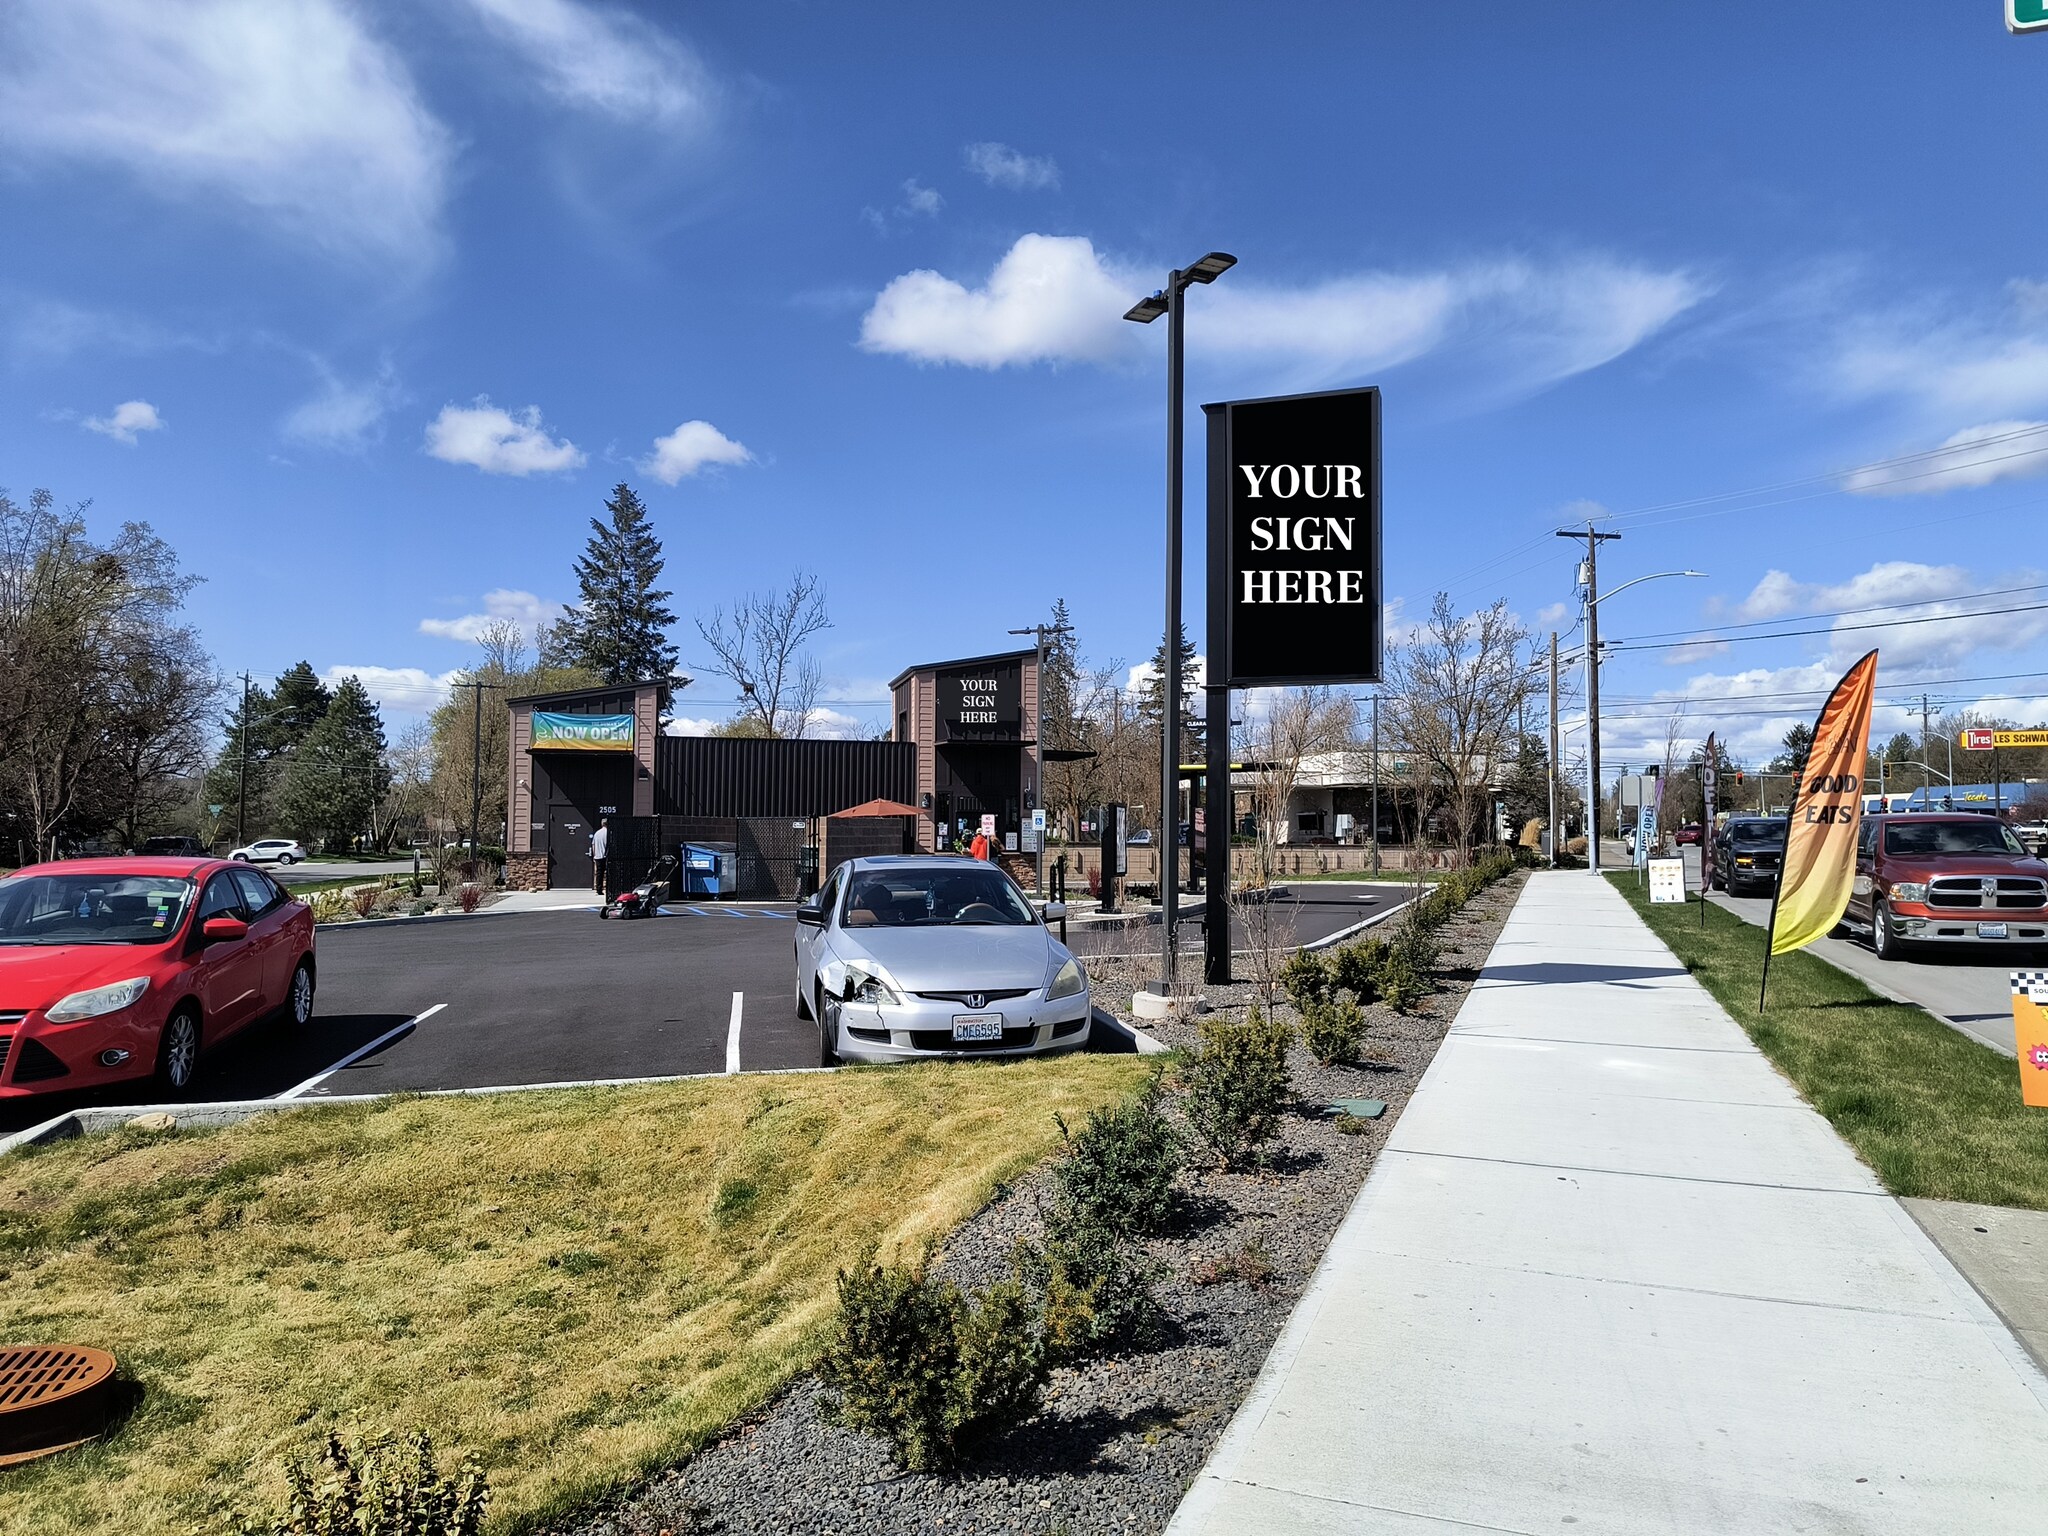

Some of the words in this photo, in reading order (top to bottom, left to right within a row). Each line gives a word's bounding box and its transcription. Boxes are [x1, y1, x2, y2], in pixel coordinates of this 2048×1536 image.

[1239, 464, 1365, 498] YOUR
[1250, 516, 1356, 551] SIGN
[1240, 570, 1364, 604] HERE
[960, 679, 998, 691] YOUR
[962, 695, 995, 707] SIGN
[960, 711, 998, 723] HERE
[552, 726, 588, 740] NOW
[590, 726, 629, 741] OPEN
[1968, 732, 1991, 747] Tires
[1994, 734, 2010, 743] LES
[2013, 734, 2048, 743] SCHWA
[1809, 775, 1857, 793] GOOD
[599, 806, 617, 814] 2505
[1805, 805, 1852, 824] EATS
[956, 1023, 1000, 1037] CME6595
